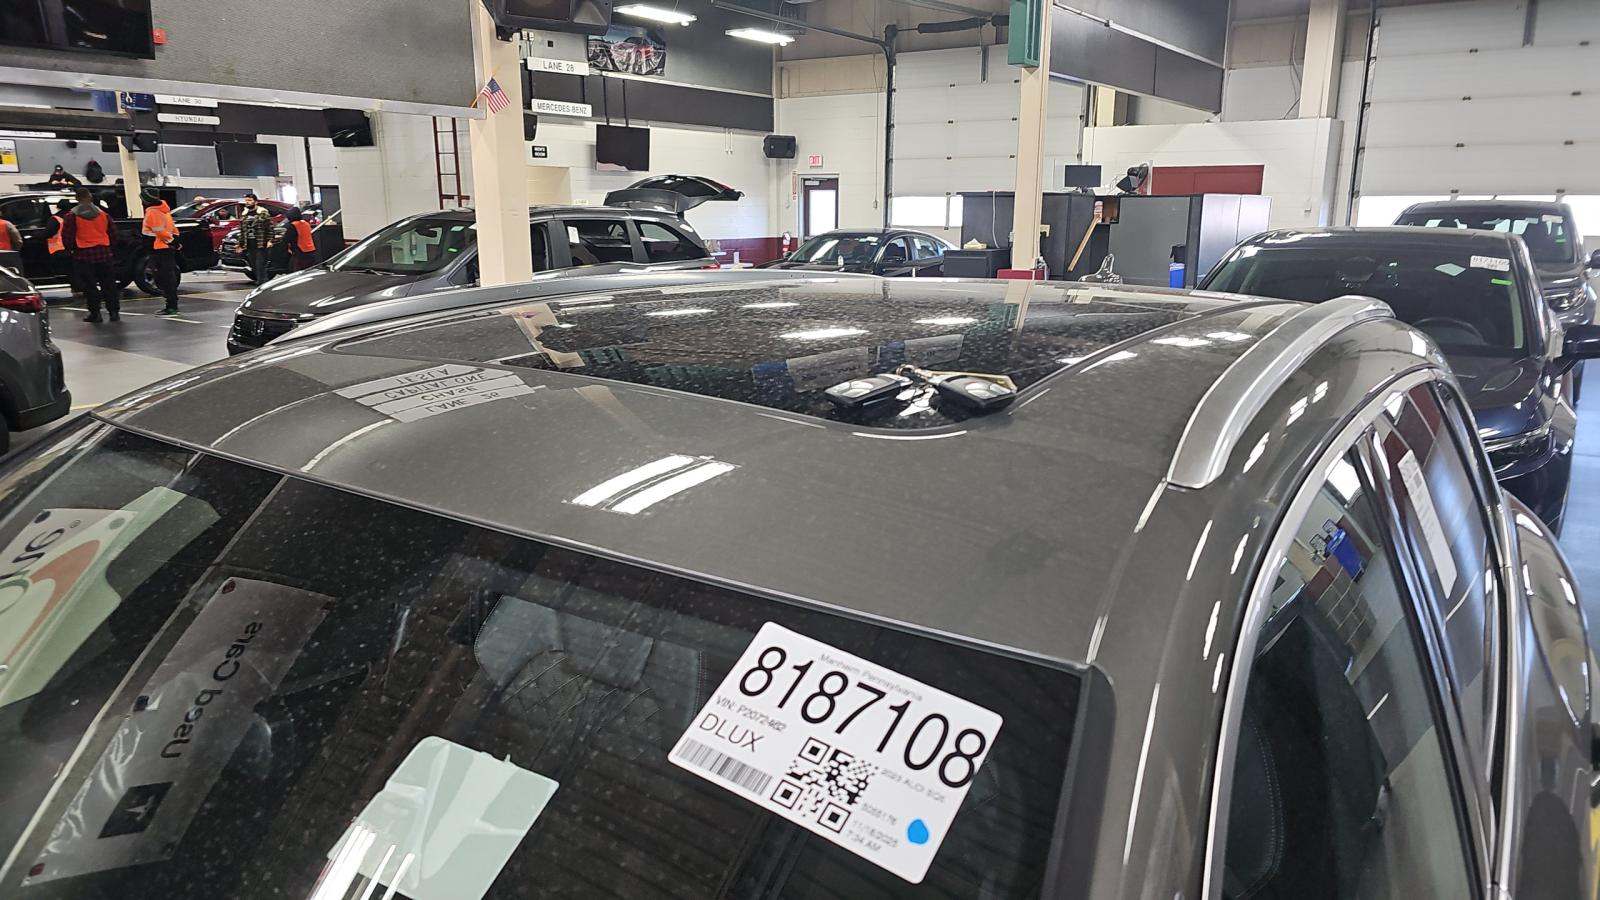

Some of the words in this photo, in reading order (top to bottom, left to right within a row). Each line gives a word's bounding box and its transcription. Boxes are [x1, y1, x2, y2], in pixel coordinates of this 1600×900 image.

[543, 62, 562, 71] LANE
[699, 713, 765, 752] DLUX
[739, 646, 987, 789] 8187108
